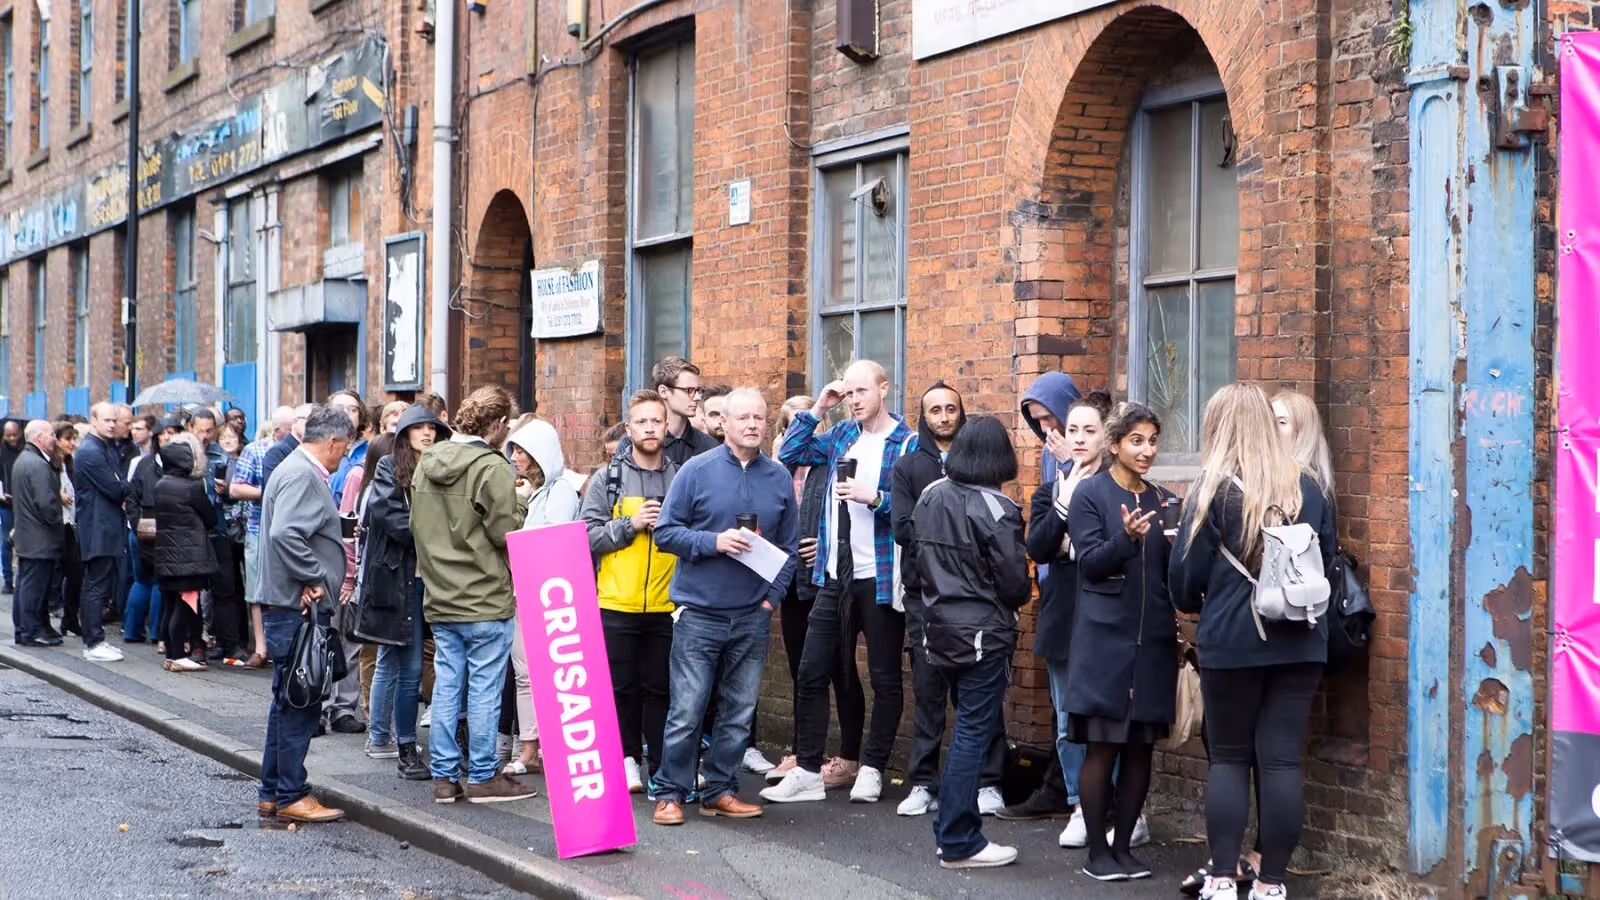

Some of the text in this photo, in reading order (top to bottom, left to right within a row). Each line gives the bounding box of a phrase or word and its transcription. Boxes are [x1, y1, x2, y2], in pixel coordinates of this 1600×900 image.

[537, 278, 555, 296] HOUSE
[562, 271, 594, 293] FASHION
[539, 577, 605, 804] CRUSADER
